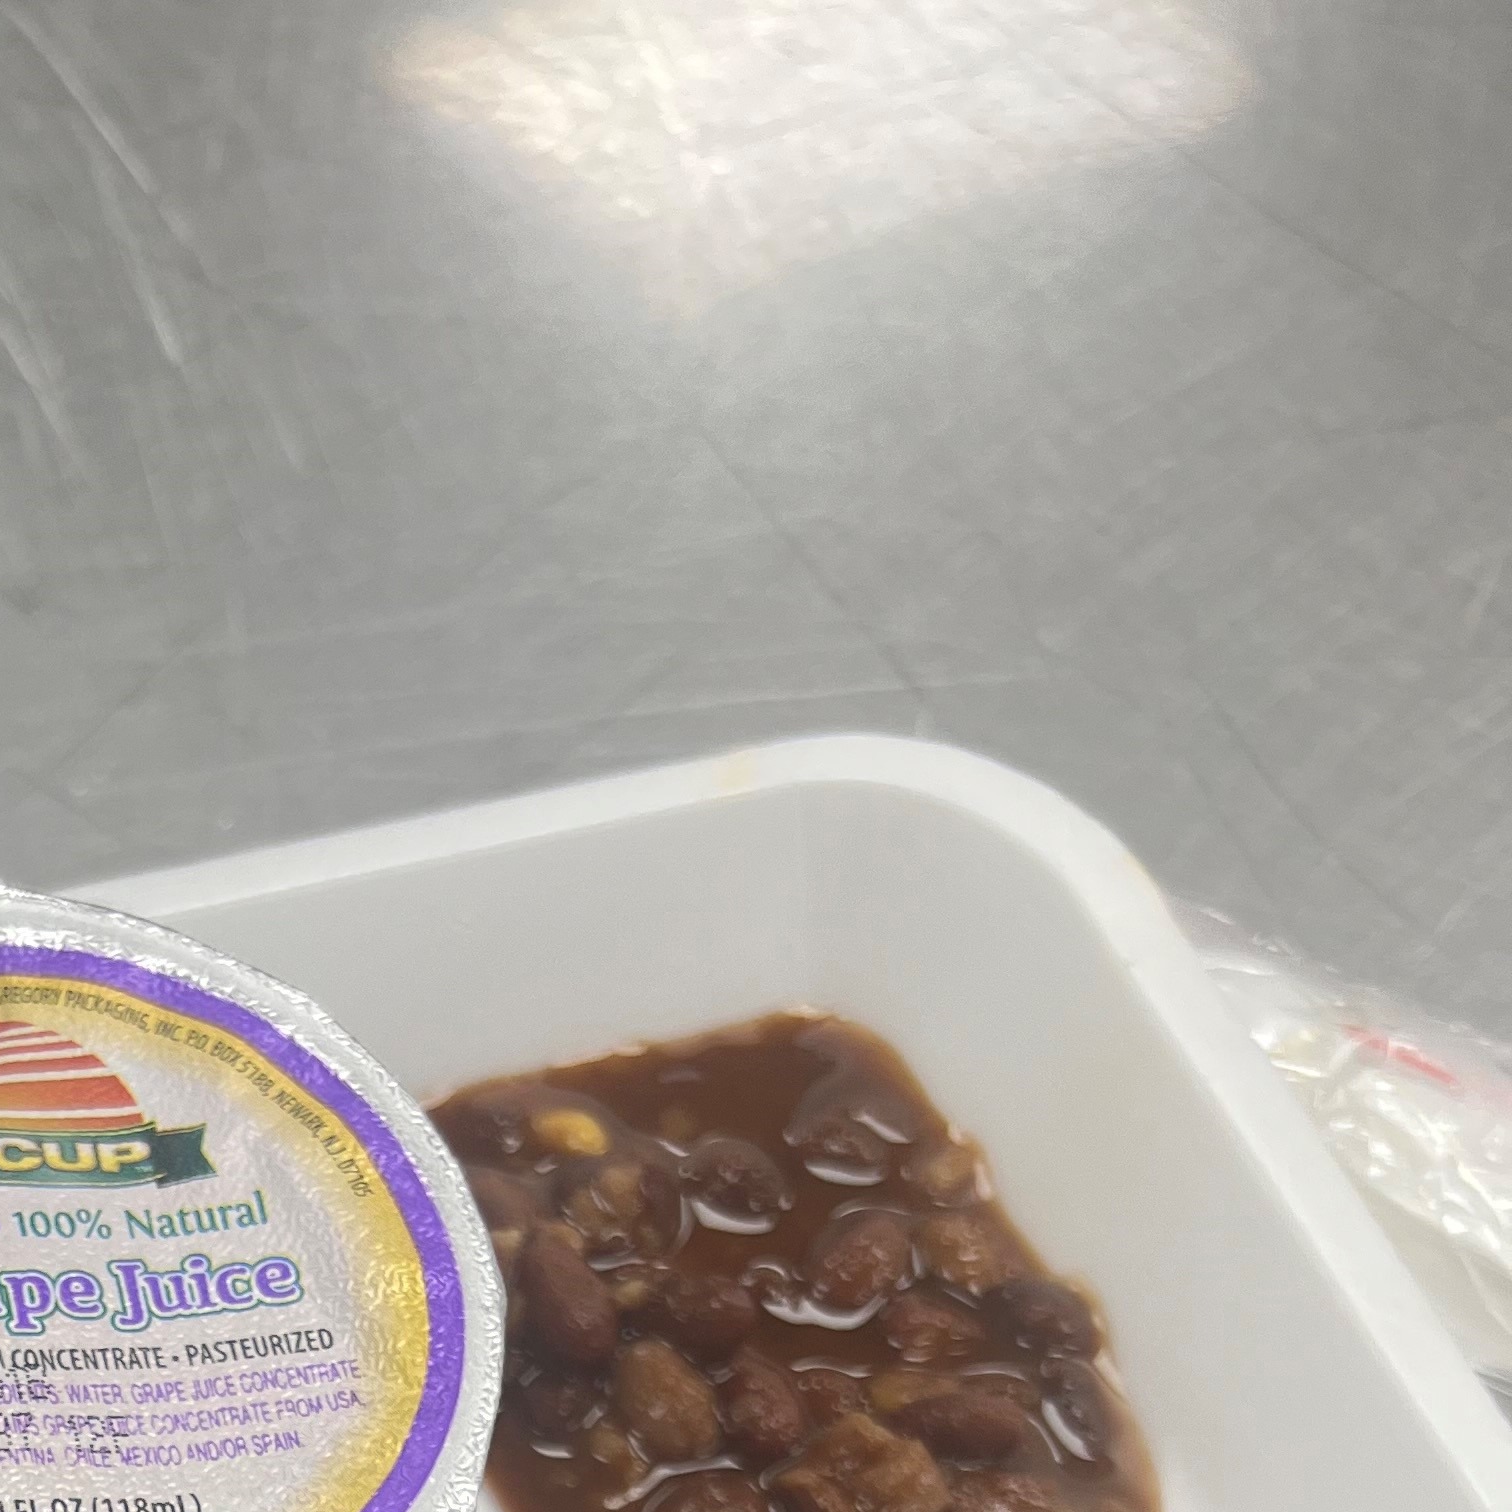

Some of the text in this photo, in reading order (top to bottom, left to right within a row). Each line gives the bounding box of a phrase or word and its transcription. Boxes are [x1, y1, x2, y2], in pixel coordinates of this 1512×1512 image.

[209, 1041, 244, 1067] BOX
[337, 1158, 376, 1198] 07105
[11, 1207, 114, 1240] 100%
[123, 1189, 270, 1240] Natural
[107, 1253, 306, 1332] Juice
[11, 1346, 167, 1372] CONCENTRATE
[185, 1328, 335, 1366] PASTEURIZED
[130, 1380, 187, 1405] GRAPE
[191, 1374, 238, 1402] JUICE
[150, 1401, 273, 1436] CONCENTRATE
[274, 1395, 324, 1420] FROM
[119, 1444, 183, 1468] MEXICO
